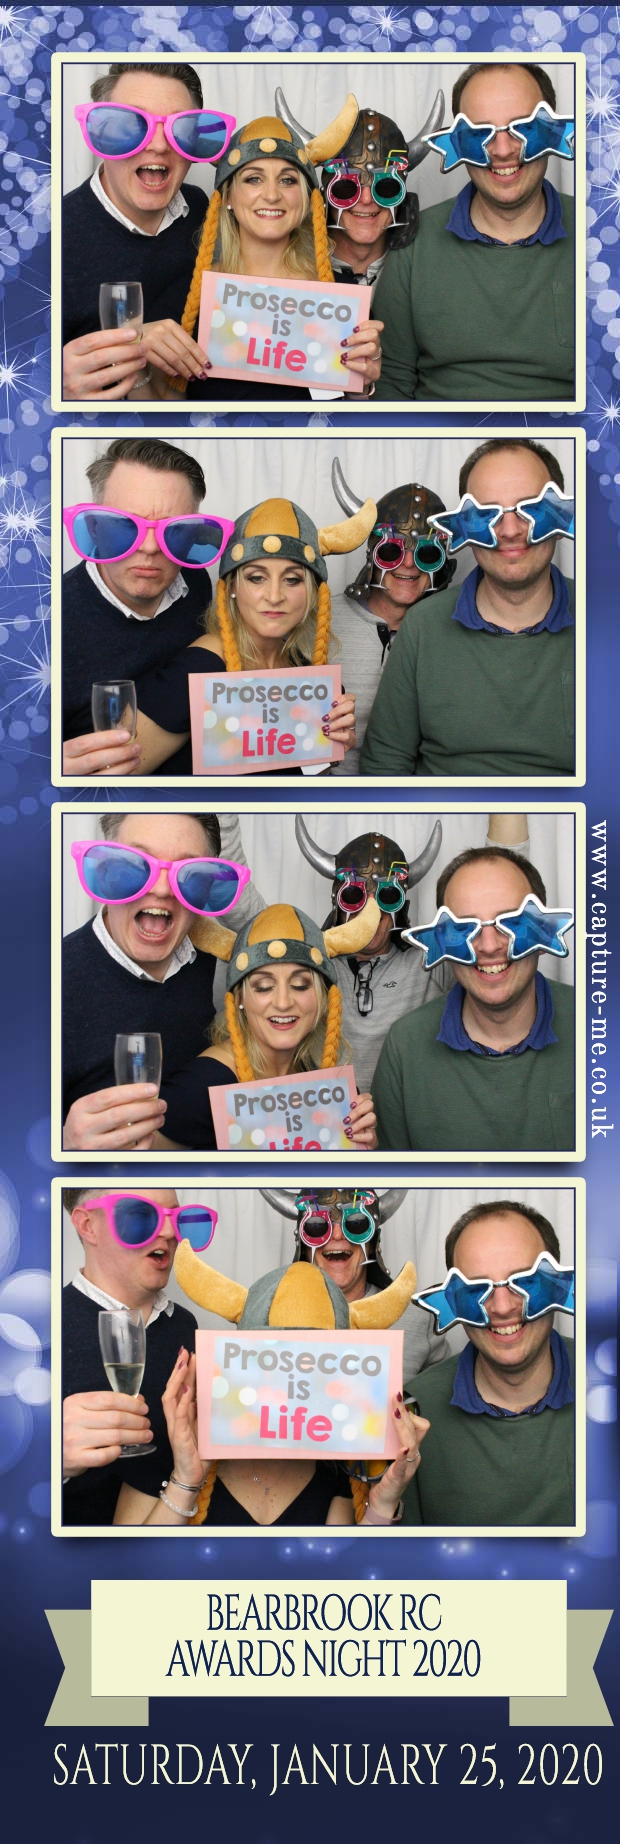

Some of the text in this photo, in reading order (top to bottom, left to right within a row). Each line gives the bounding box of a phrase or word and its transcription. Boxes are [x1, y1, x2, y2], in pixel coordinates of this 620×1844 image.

[222, 283, 352, 323] Prosecco
[271, 314, 292, 336] is
[246, 337, 307, 372] Life
[212, 682, 328, 704] Prosecco
[262, 703, 279, 724] is
[242, 728, 296, 757] Life
[233, 1086, 346, 1117] Prosecco
[285, 1111, 303, 1132] is
[223, 1342, 382, 1377] Prosecco
[287, 1373, 310, 1400] is
[259, 1405, 333, 1442] Life
